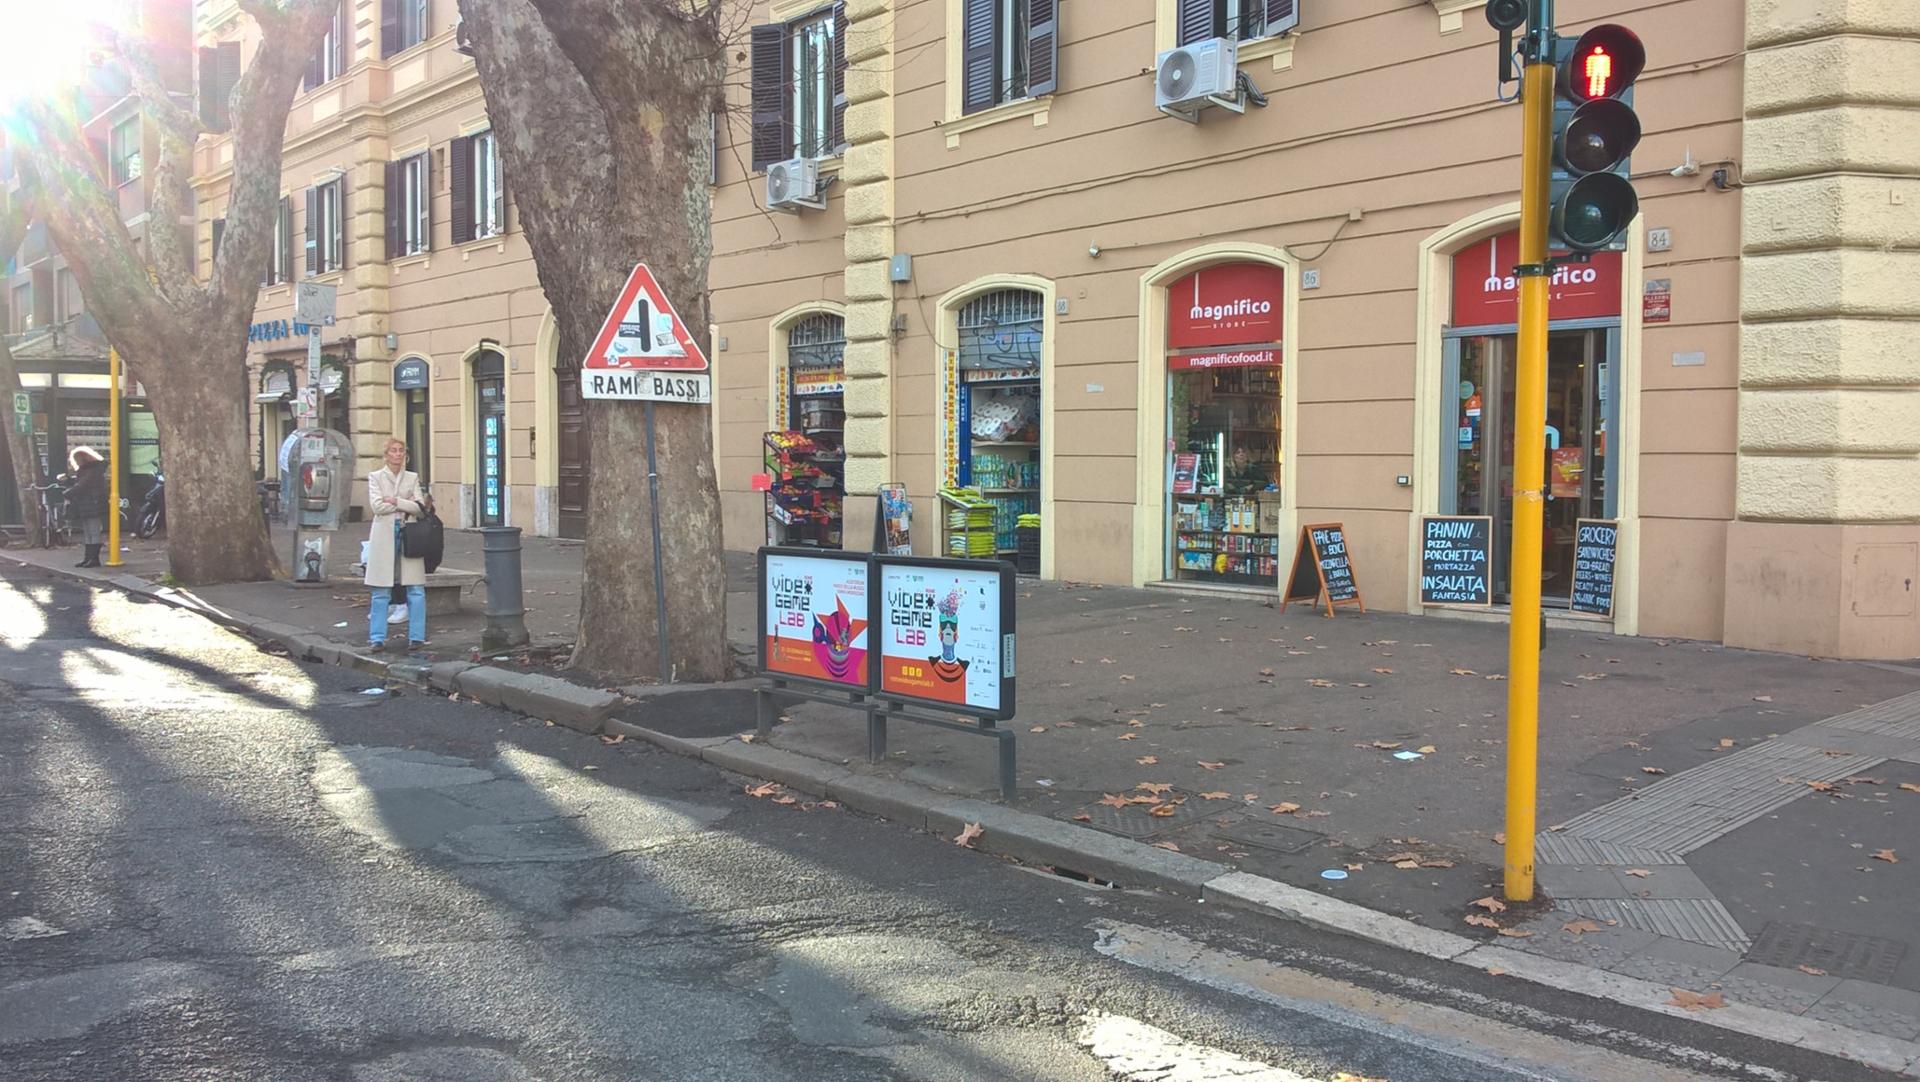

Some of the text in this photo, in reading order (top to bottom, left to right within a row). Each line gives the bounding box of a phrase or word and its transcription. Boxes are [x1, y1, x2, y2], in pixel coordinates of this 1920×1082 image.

[1651, 232, 1667, 247] 84
[1304, 272, 1316, 286] 86
[1484, 266, 1597, 292] mafico
[1213, 321, 1246, 329] STORE
[1190, 351, 1274, 367] magnificofood.it
[593, 375, 701, 398] RAMI BASSI
[1427, 522, 1475, 539] PANINI
[1579, 527, 1617, 545] GROCERY
[1427, 540, 1452, 548] PIZZA
[1424, 549, 1485, 562] PORCHETTA
[1577, 546, 1615, 563] SANDWICHES
[1434, 563, 1476, 571] MORTAZZA
[1422, 575, 1486, 593] INSALATA
[1600, 584, 1612, 593] EAT
[1432, 592, 1476, 601] FANTASIA
